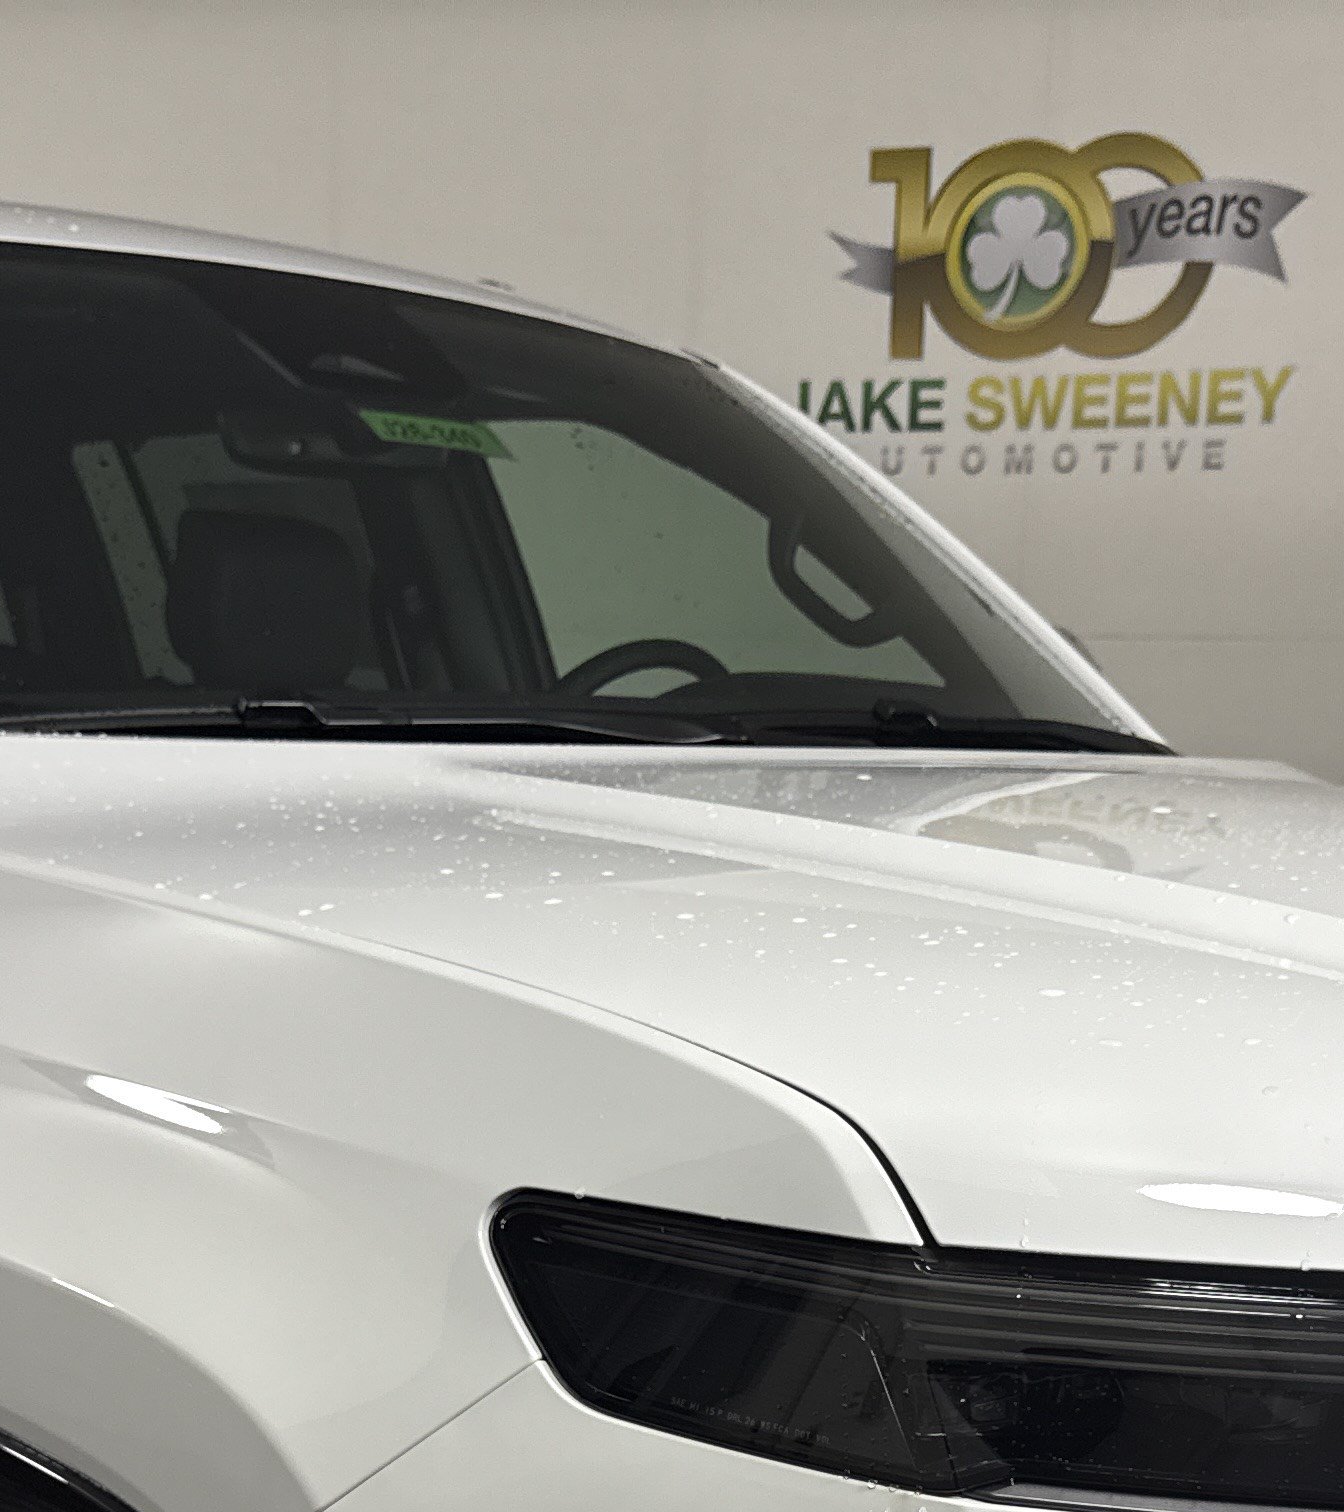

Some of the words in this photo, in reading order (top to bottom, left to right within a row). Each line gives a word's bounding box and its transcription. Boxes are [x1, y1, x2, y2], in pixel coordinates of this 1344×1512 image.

[869, 131, 1214, 361] 100
[1126, 189, 1264, 258] years
[965, 364, 1296, 432] SWEENEY
[881, 438, 1228, 476] UTOMOTIVE
